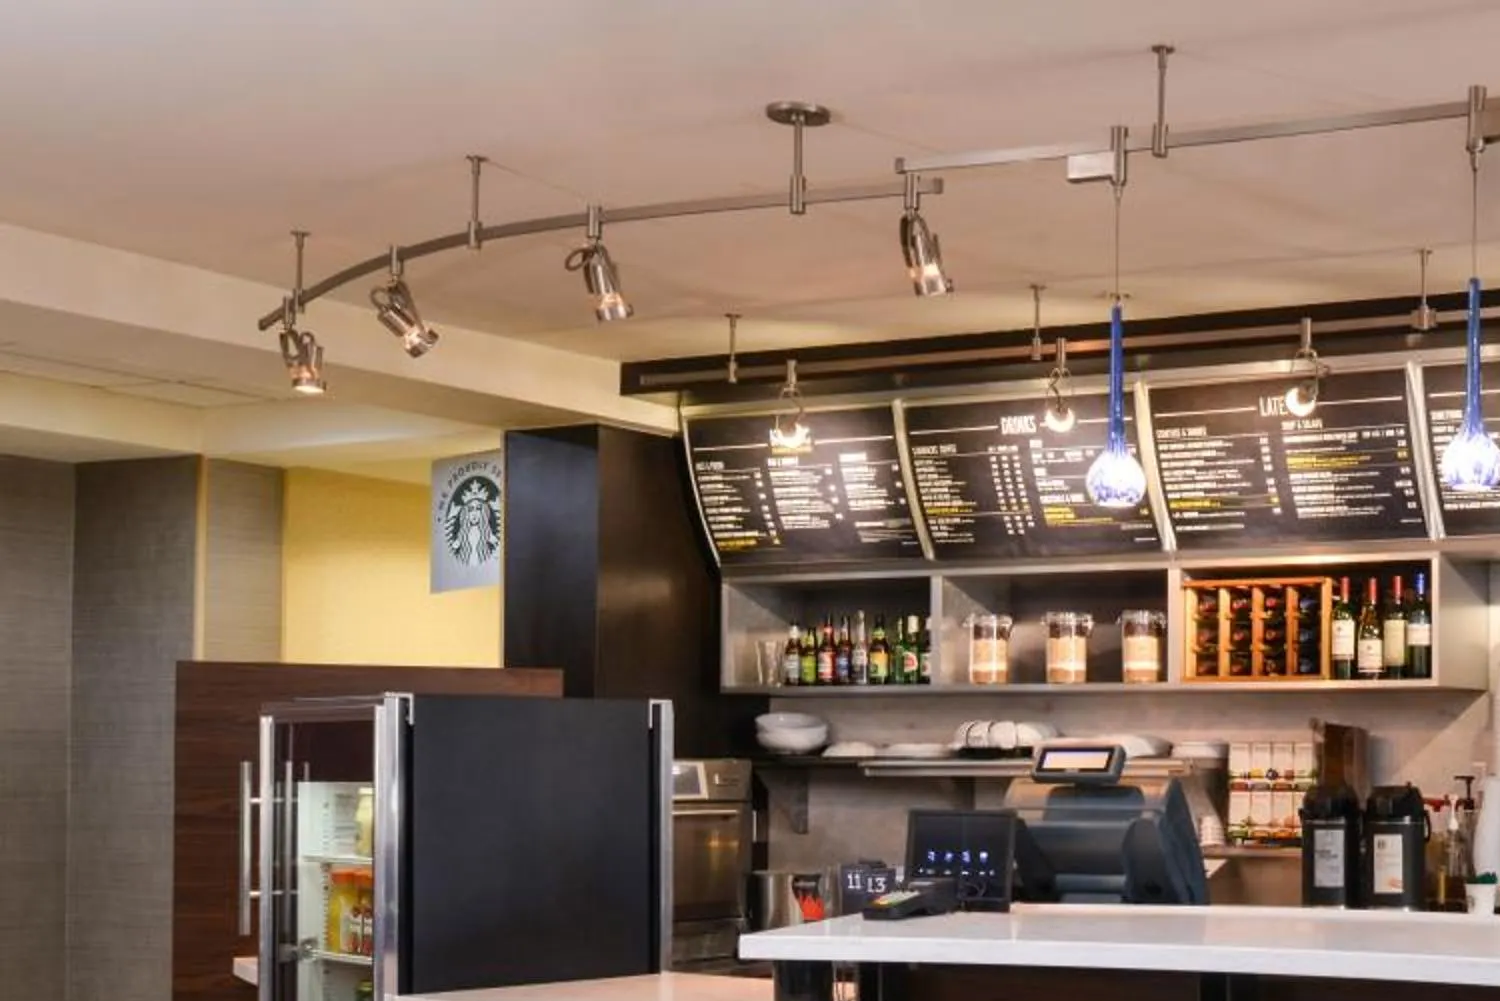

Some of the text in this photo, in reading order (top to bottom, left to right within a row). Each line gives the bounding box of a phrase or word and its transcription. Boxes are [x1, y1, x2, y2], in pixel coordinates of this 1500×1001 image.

[1258, 395, 1289, 417] LATE
[847, 873, 862, 889] 11
[867, 877, 886, 893] 13
